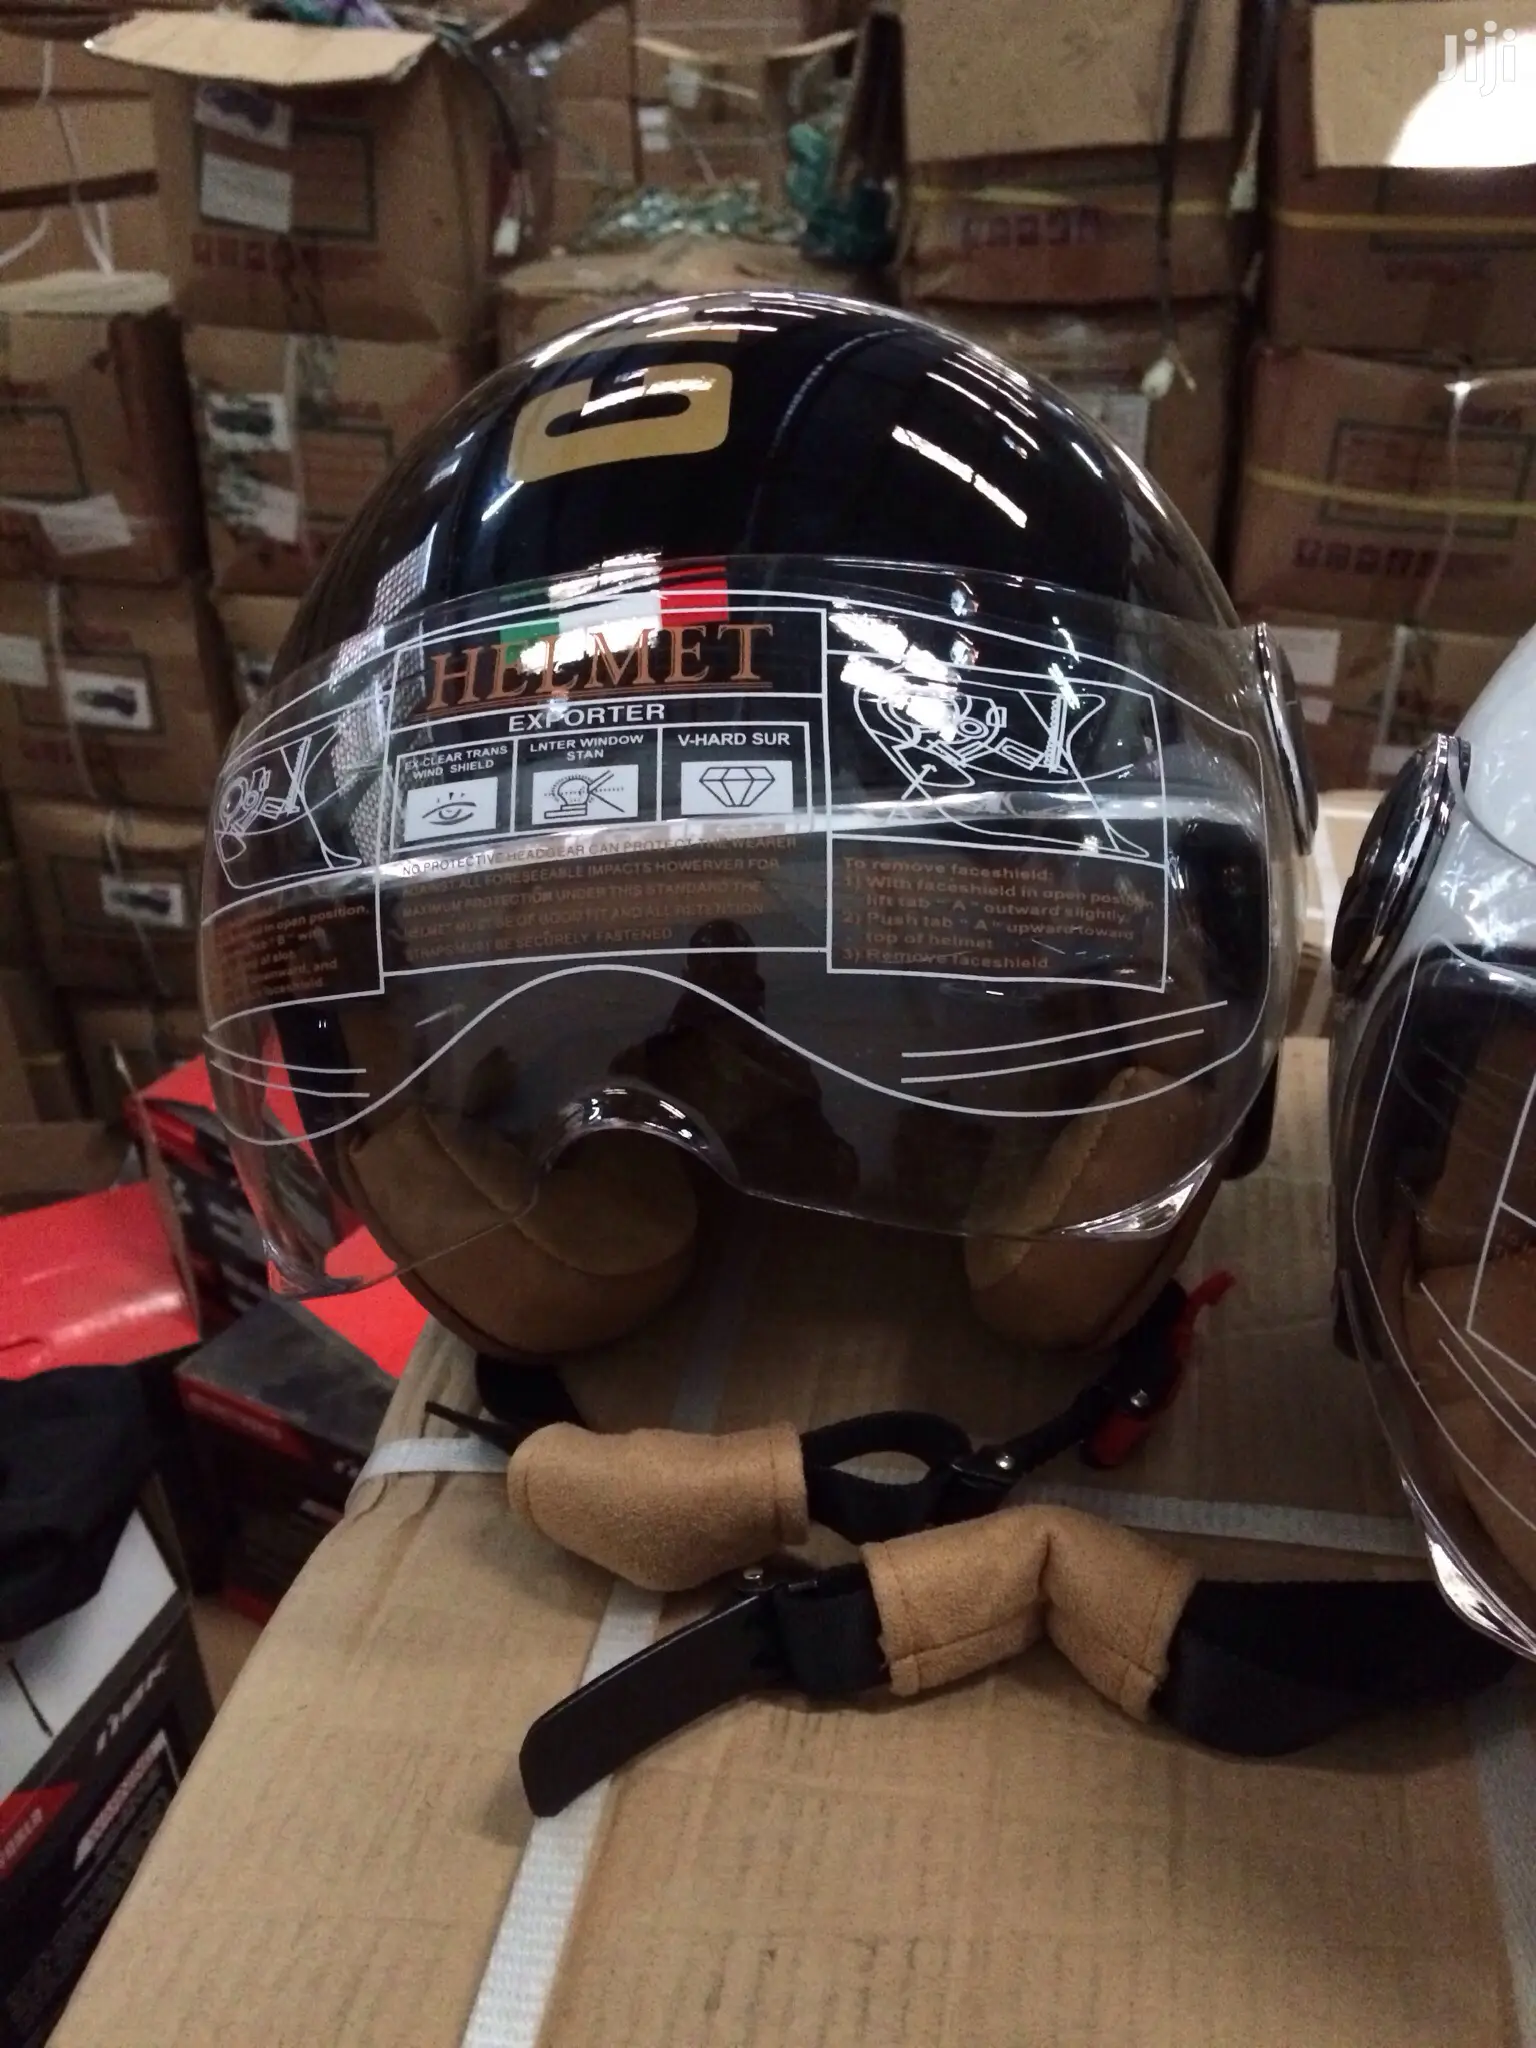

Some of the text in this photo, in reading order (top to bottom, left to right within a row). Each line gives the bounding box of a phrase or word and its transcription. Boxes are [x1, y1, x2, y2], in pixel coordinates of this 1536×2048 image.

[427, 623, 774, 711] HELMET
[508, 703, 667, 733] EXPORTER
[530, 734, 645, 752] LNTER WINDOW
[678, 732, 791, 748] V-HARD SUR
[404, 745, 508, 771] EX-CLEAR TRANS
[566, 747, 604, 761] STAN
[412, 759, 495, 780] WIND SHIELD
[403, 864, 421, 876] NO
[424, 850, 505, 872] PROTECTIVE
[506, 844, 585, 860] HEADGEAR
[589, 842, 619, 855] CAN
[624, 837, 691, 853] PROTECT
[732, 833, 797, 851] WEARER
[844, 855, 867, 870] To
[871, 860, 946, 875] remove
[459, 876, 481, 889] ALL
[588, 862, 652, 877] IMPACTS
[656, 858, 744, 874] HOWERVER
[748, 857, 781, 871] FOR
[555, 886, 608, 902] UNDER
[609, 883, 643, 898] THIS
[646, 881, 729, 897] STANDARD
[732, 881, 762, 893] THE
[866, 875, 912, 890] With
[917, 880, 1016, 899] faceshield
[1021, 884, 1038, 898] in
[1043, 889, 1087, 903] open
[610, 905, 642, 921] AND
[644, 905, 670, 919] ALL
[866, 893, 894, 907] lift
[897, 895, 931, 909] tab
[983, 903, 1060, 918] outward
[277, 914, 306, 932] open
[867, 910, 918, 928] Push
[922, 915, 954, 929] tab
[1076, 924, 1134, 941] toward
[494, 936, 513, 951] BE
[517, 931, 589, 950] SECURELY
[596, 928, 673, 943] FASTENED
[865, 931, 995, 950] top of helmet
[865, 947, 948, 964] Remove
